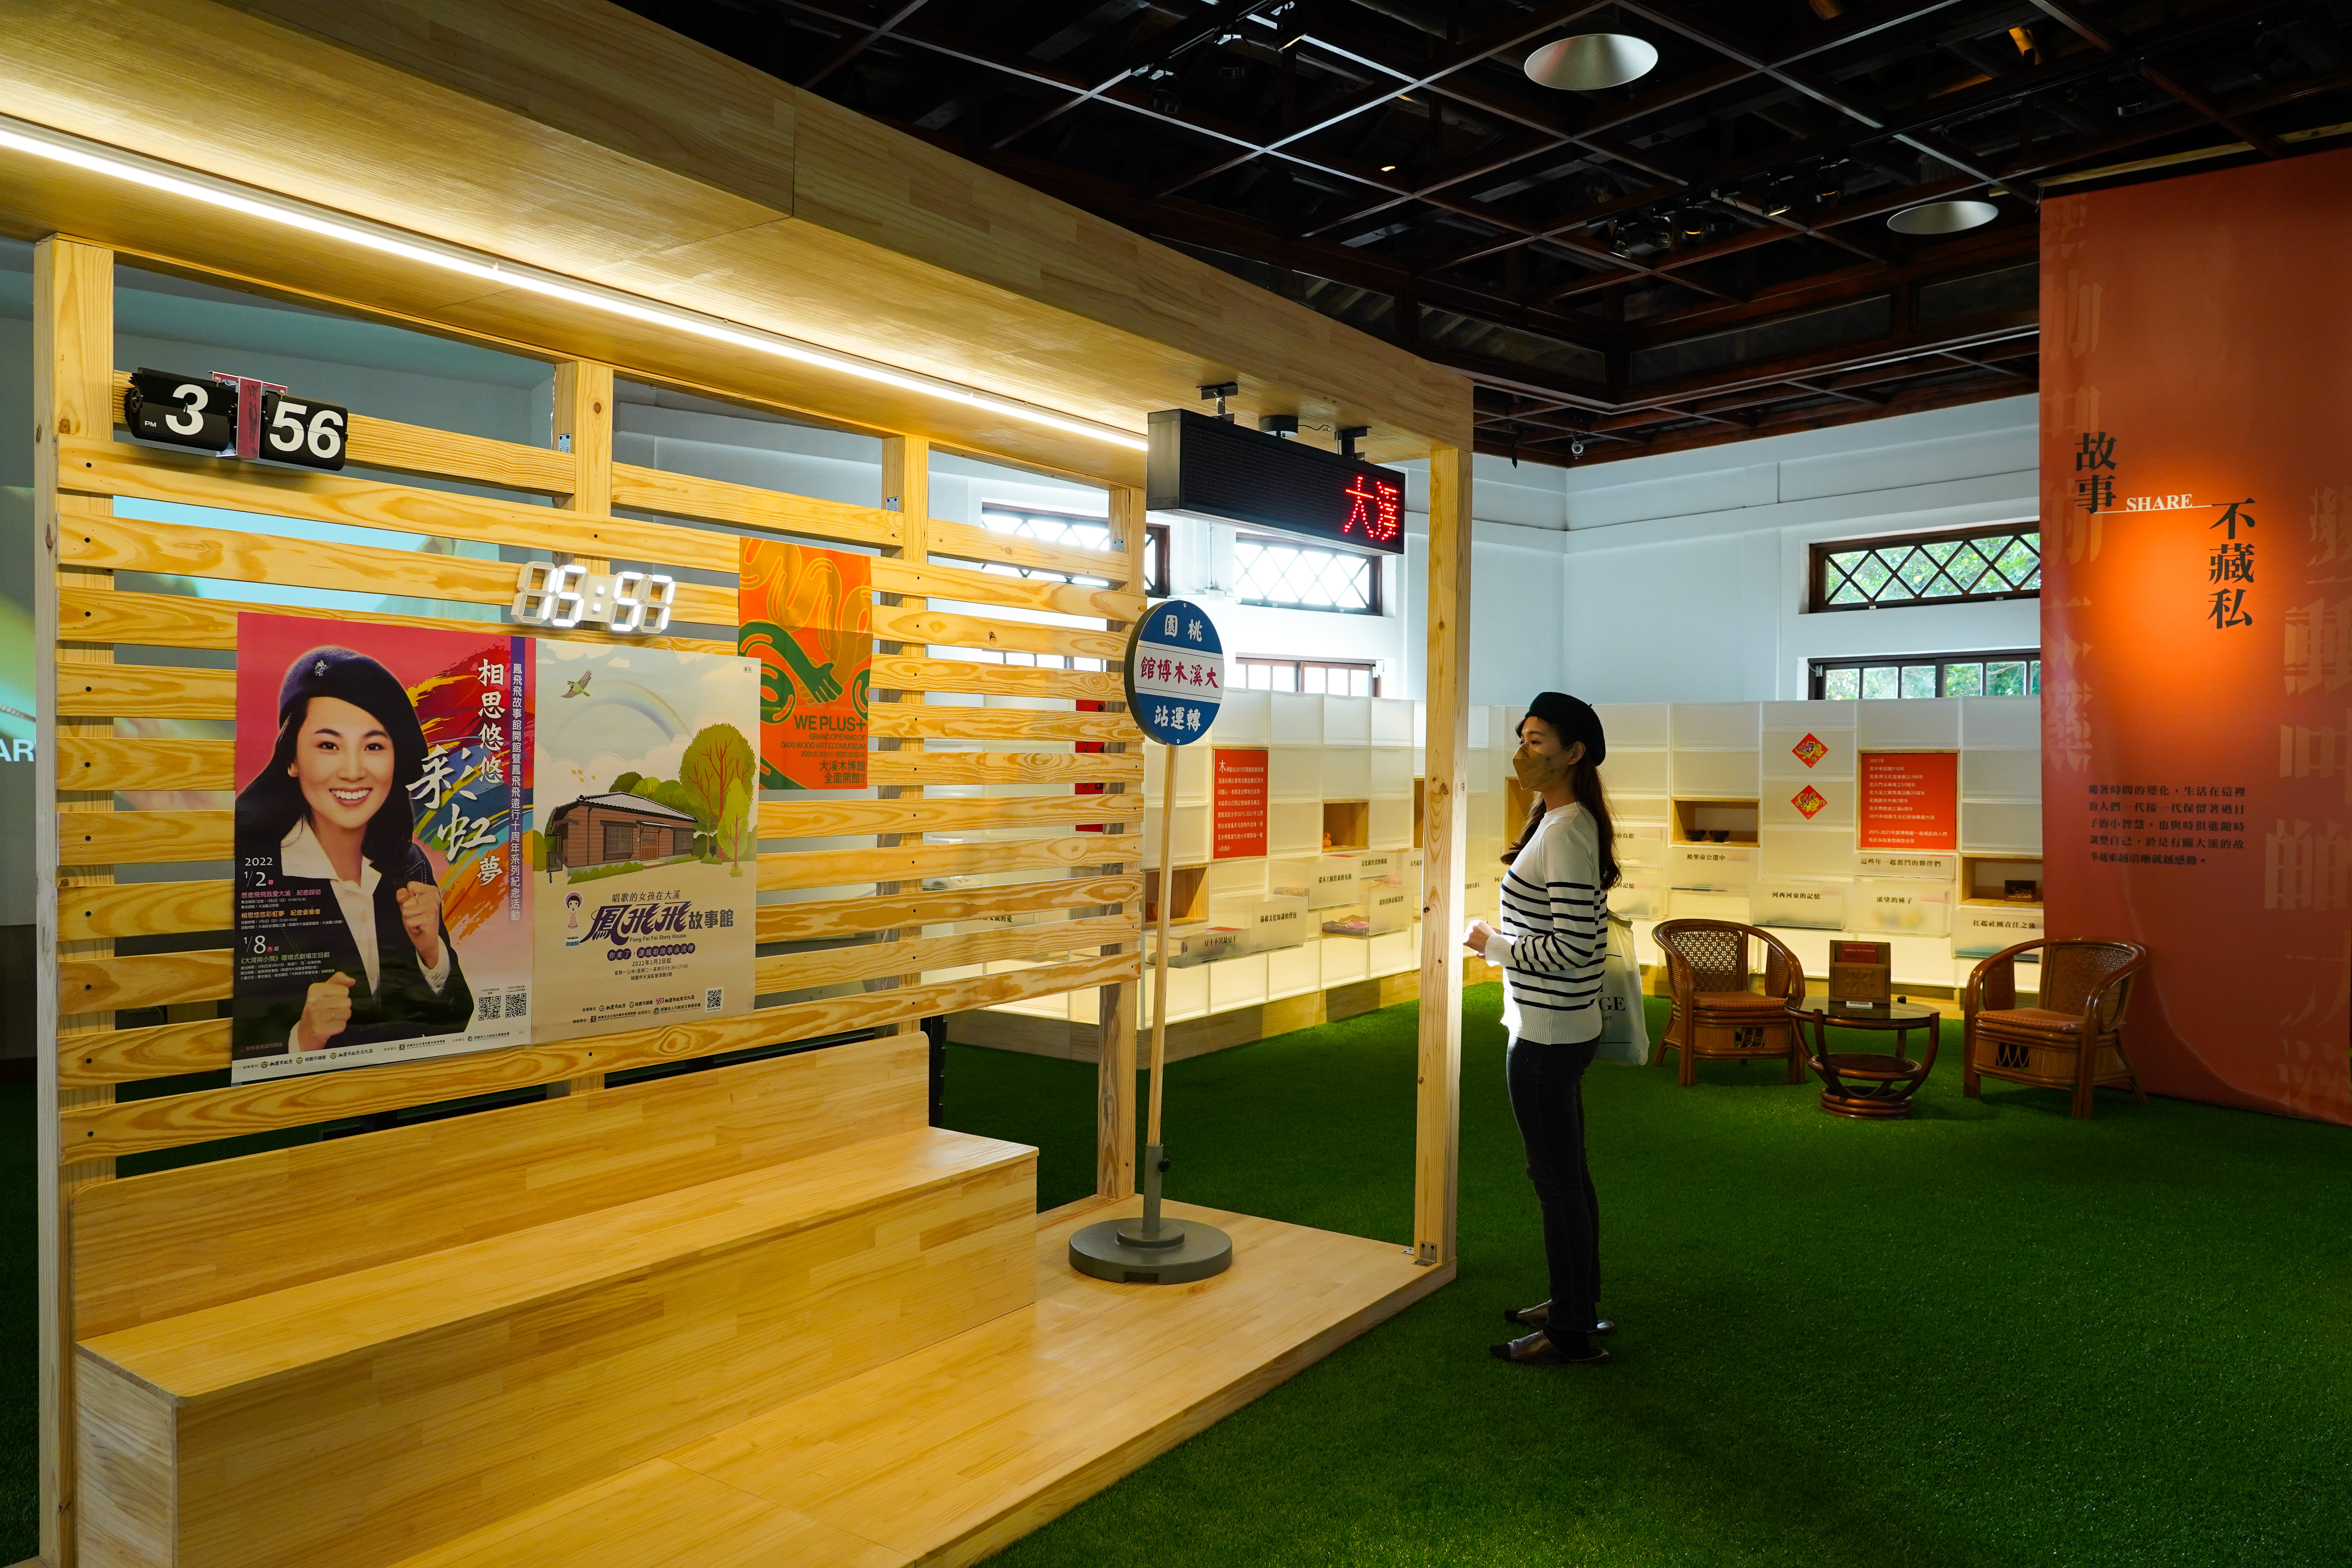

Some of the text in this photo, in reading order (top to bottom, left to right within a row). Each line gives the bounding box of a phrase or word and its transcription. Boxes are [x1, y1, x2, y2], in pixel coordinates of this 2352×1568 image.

[165, 384, 344, 458] 3 56
[2074, 432, 2117, 514] 故事
[2126, 494, 2192, 511] SHARE
[2207, 498, 2256, 629] 不藏私
[477, 658, 505, 784] 相思悠悠
[794, 715, 866, 732] WE PLUS+
[820, 760, 866, 771] 大溪木博館
[510, 663, 522, 921] 鳳飛飛故事館開館暨鳳飛飛遠行十周年系列紀念活動
[245, 857, 273, 866] 2022
[612, 890, 681, 903] 唱歌的女孩在大溪
[1772, 891, 1820, 900] 河西河東的記憶
[580, 901, 734, 946] 鳳飛飛 故事館
[1205, 935, 1237, 947] 豆干不只是豆干
[632, 958, 671, 967] 2022年1月2日起
[338, 1049, 373, 1058] 桃園市政府文化局
